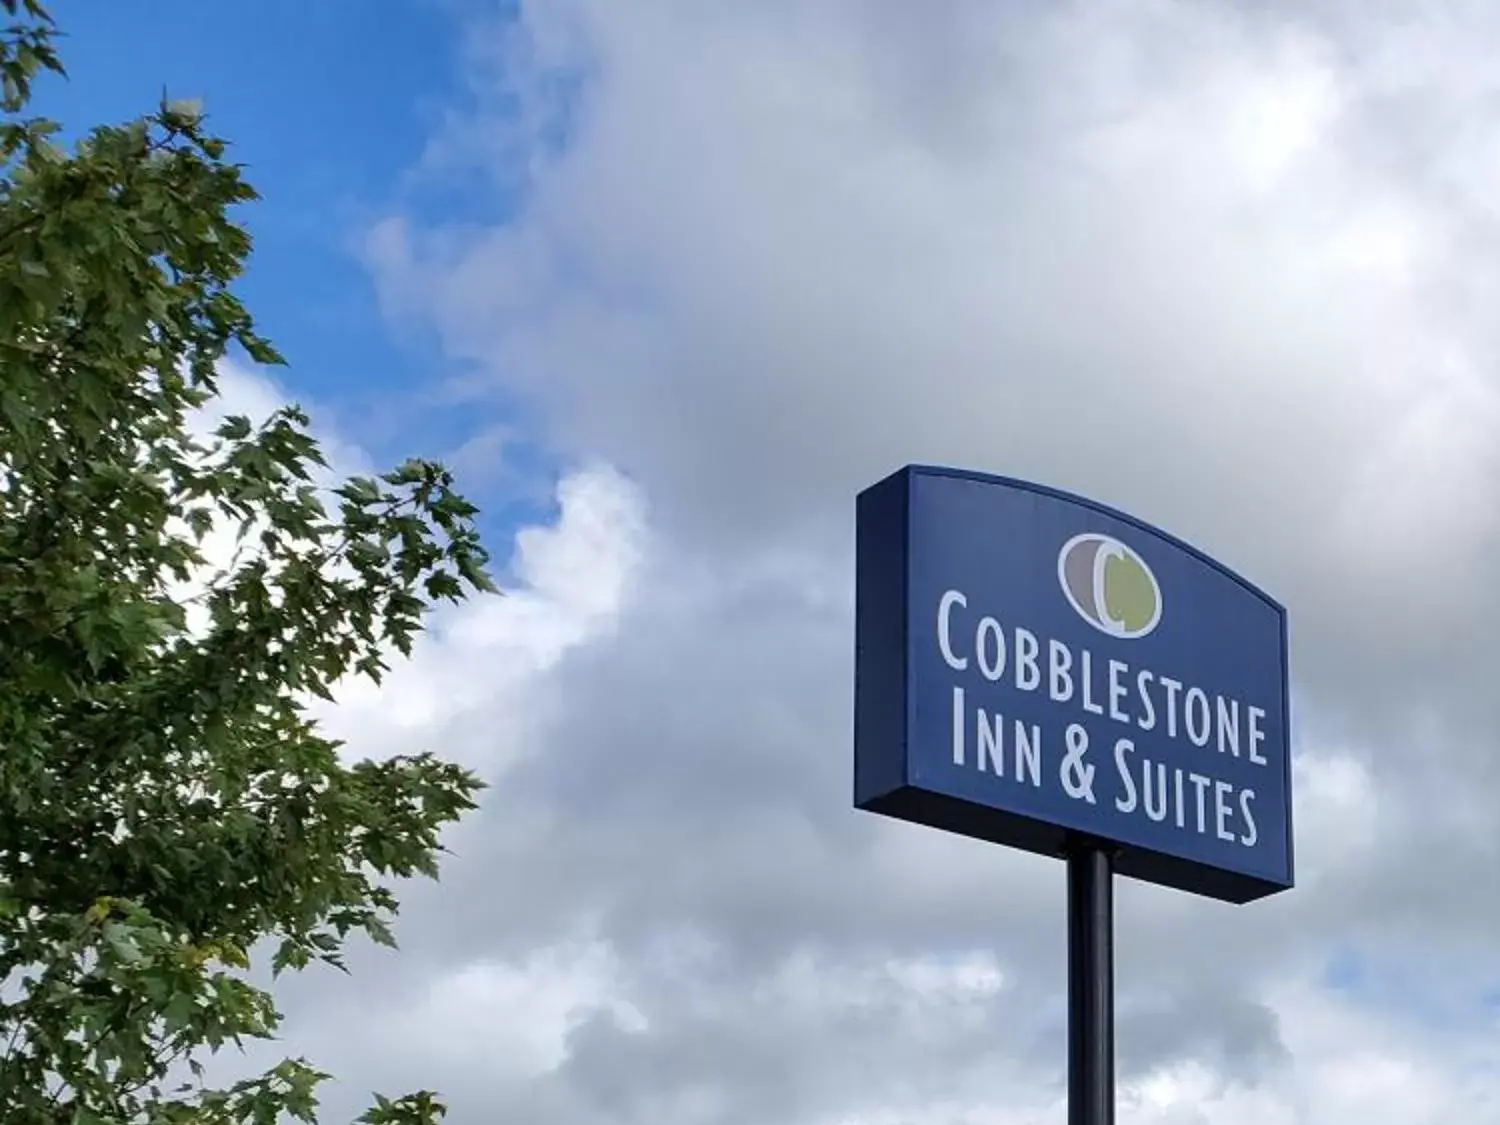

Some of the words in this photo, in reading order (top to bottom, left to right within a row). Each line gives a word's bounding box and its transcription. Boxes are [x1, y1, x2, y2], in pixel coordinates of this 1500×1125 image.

[937, 589, 1268, 766] COBBLESTONE
[952, 686, 1042, 787] INN
[1059, 723, 1097, 805] &
[1113, 739, 1258, 848] SUITES
